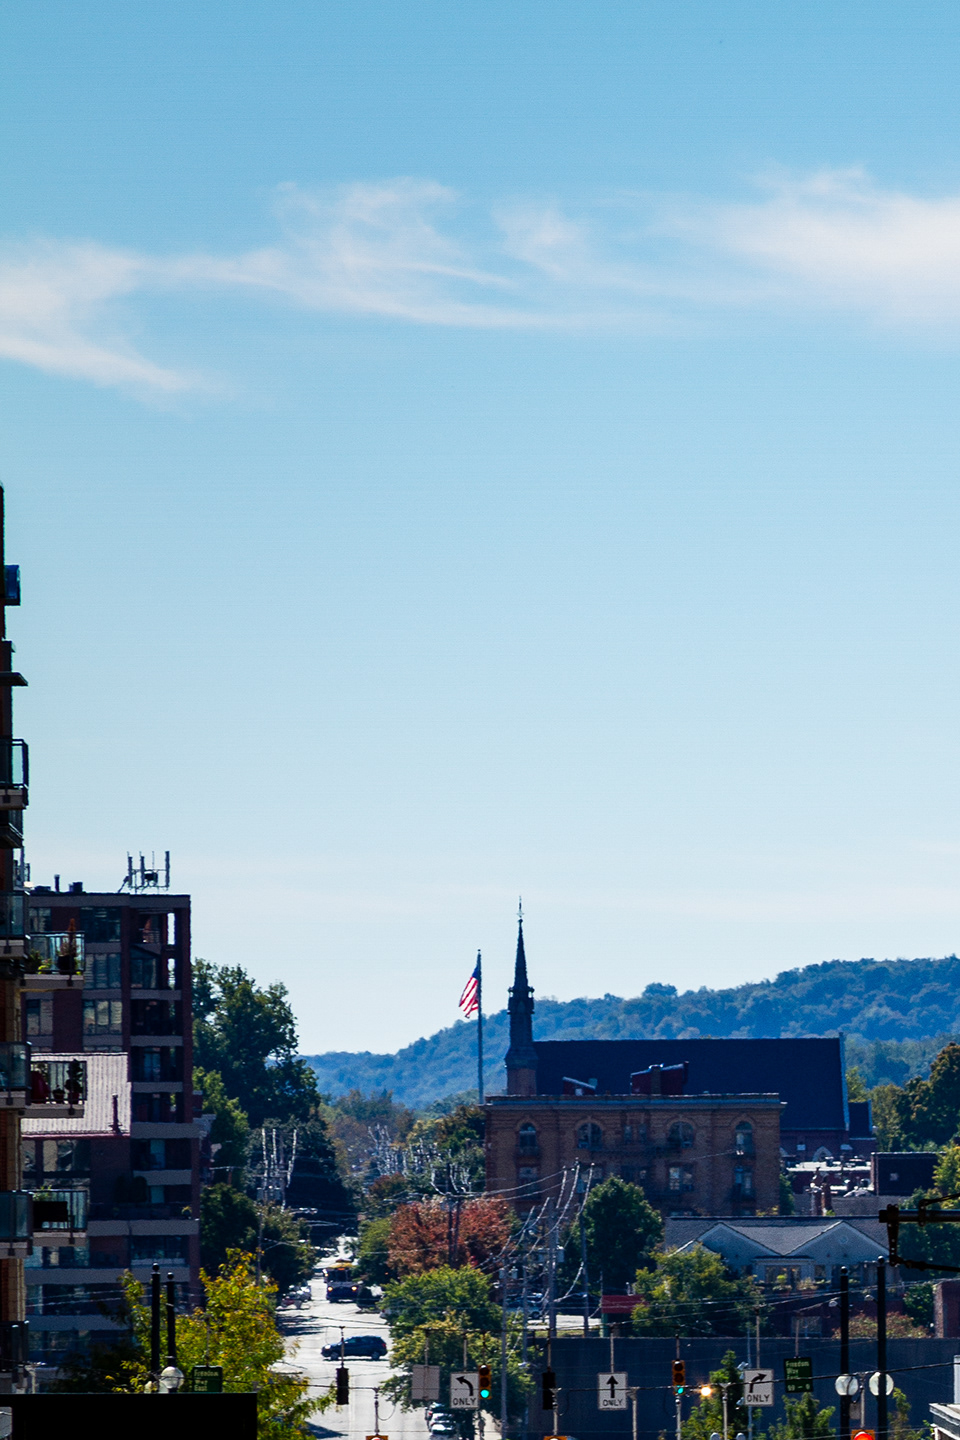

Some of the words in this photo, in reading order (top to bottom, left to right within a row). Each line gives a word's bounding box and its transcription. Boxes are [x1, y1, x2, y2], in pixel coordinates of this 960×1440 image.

[452, 1397, 477, 1406] ONLY
[602, 1399, 623, 1407] ONLY
[747, 1394, 770, 1403] ONLY
